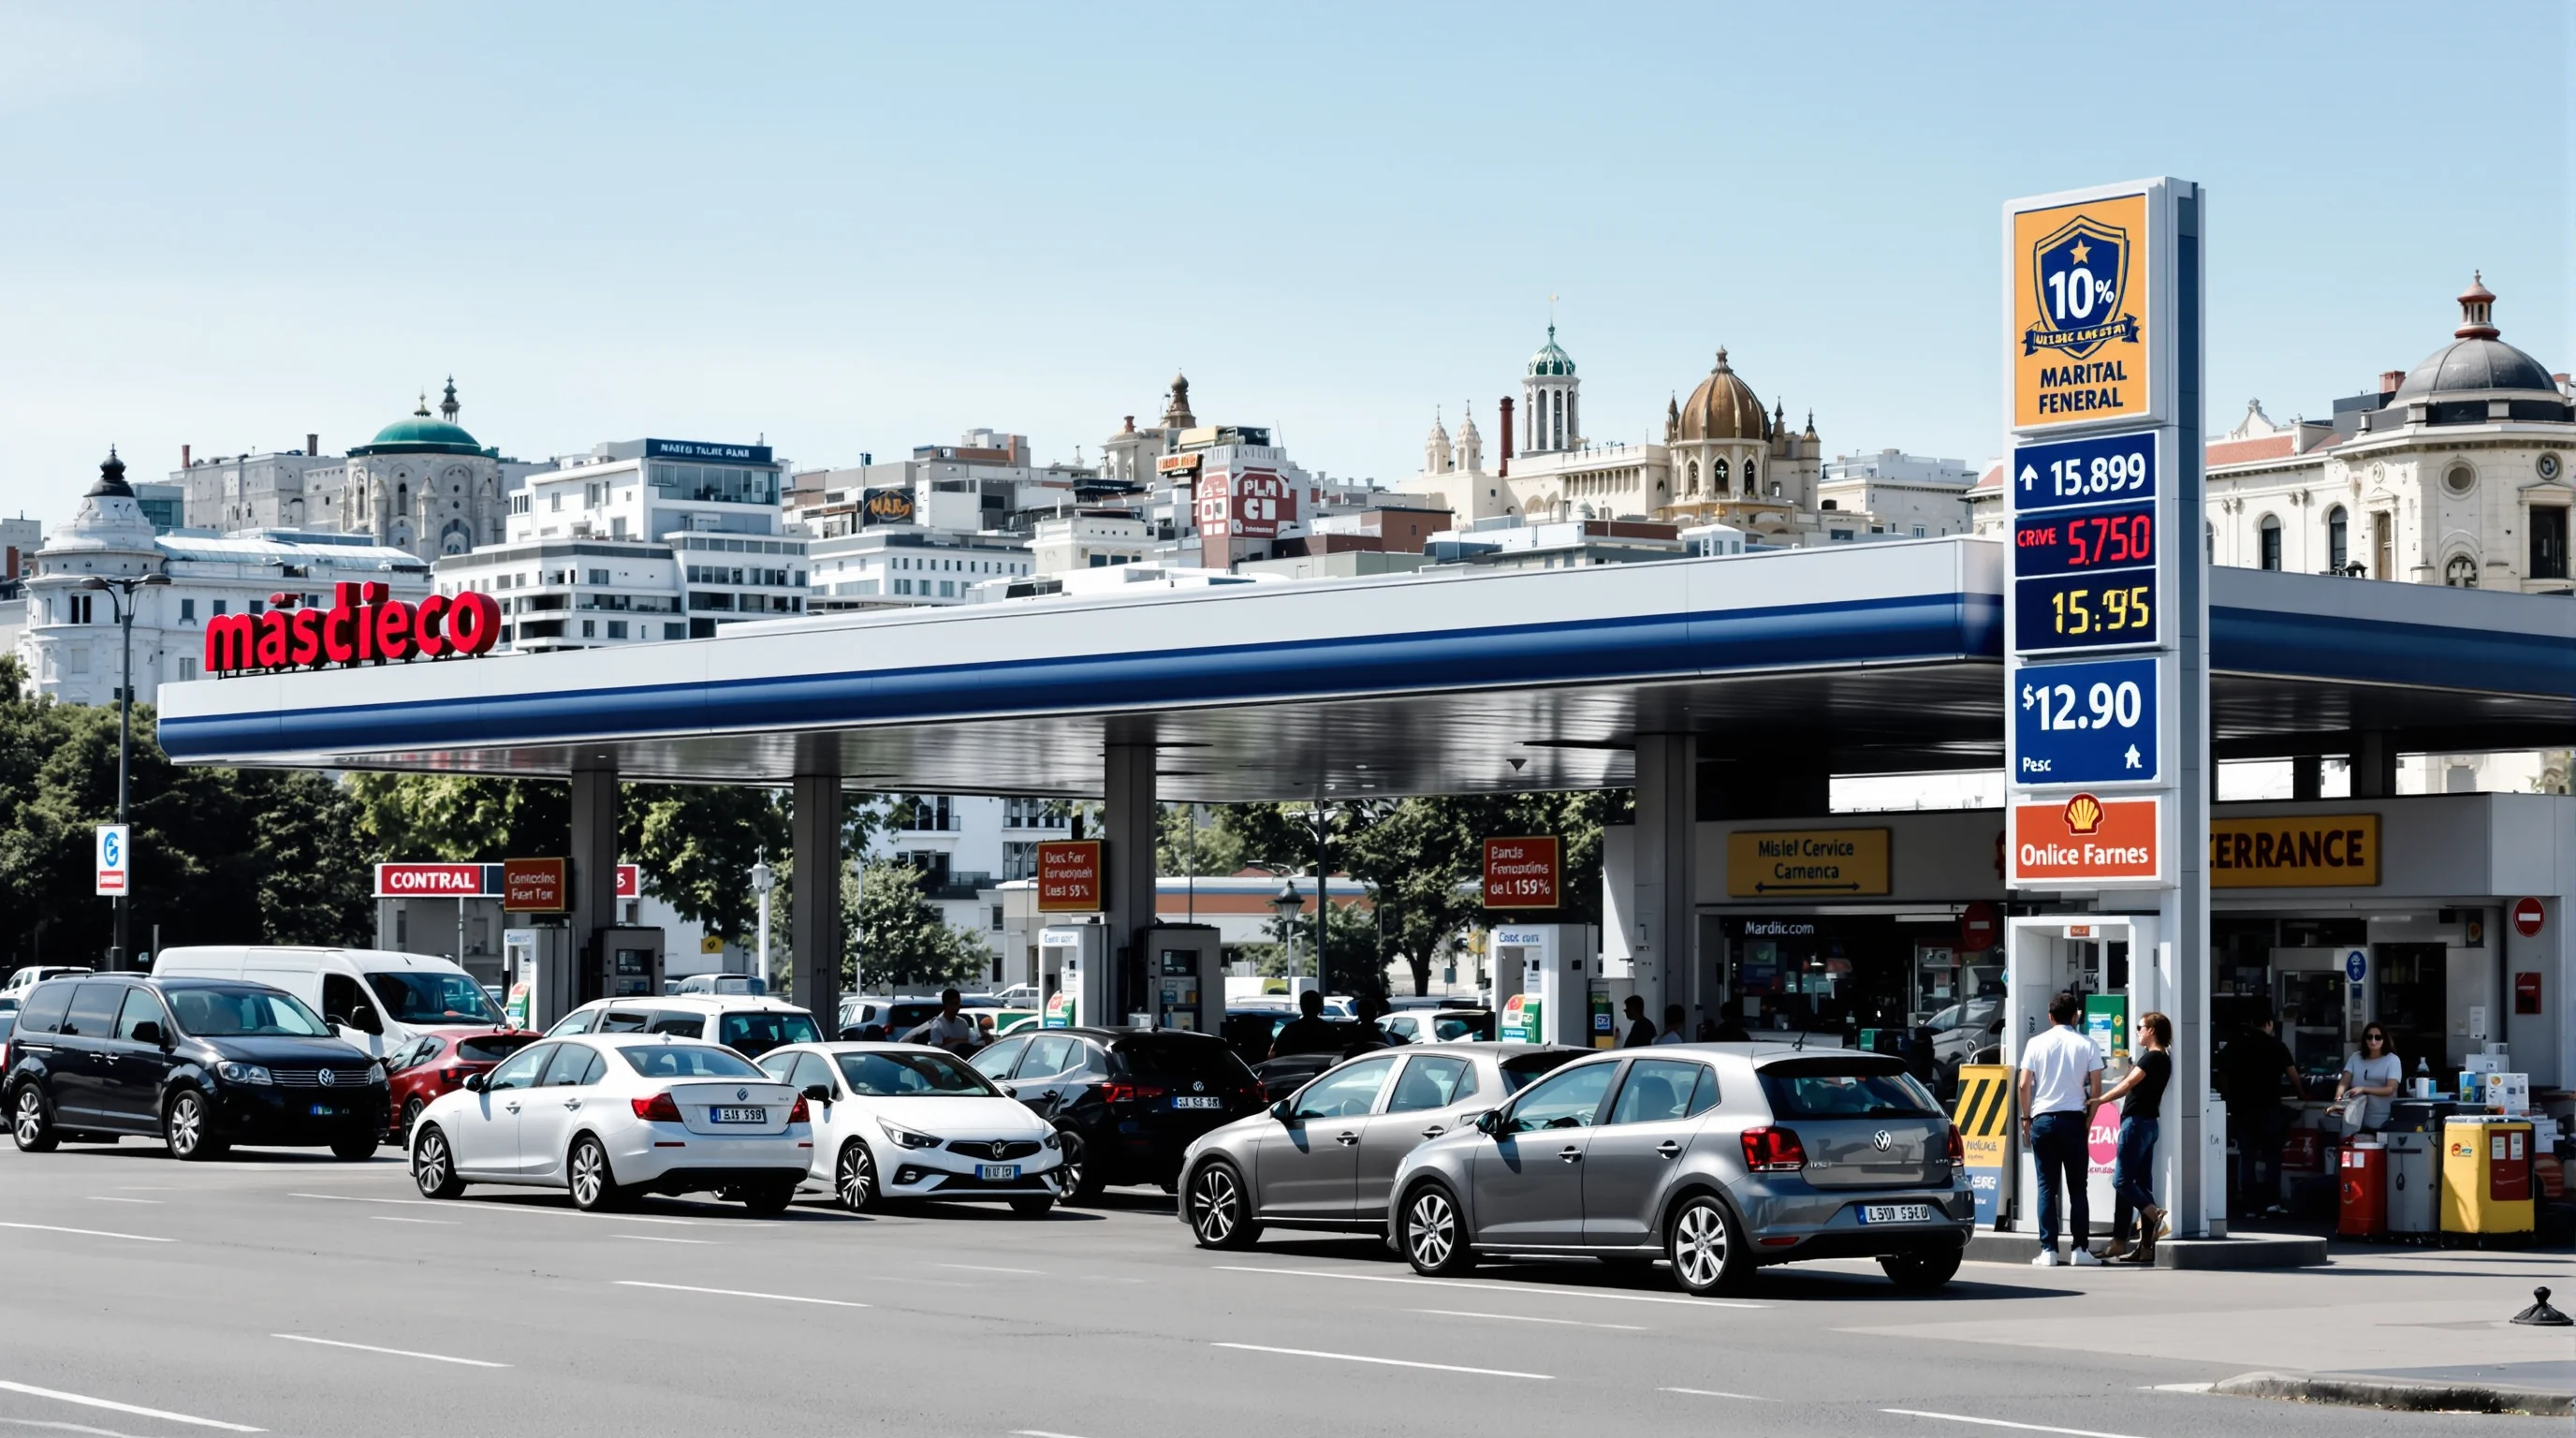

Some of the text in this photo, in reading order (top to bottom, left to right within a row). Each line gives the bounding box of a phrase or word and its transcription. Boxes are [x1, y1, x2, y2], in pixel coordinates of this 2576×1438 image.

[2048, 267, 2115, 320] 10%
[2040, 360, 2128, 389] MARITAL
[2039, 387, 2124, 415] FENERAL
[2050, 452, 2146, 497] 15.899
[2017, 528, 2057, 547] CRIVE
[2022, 681, 2142, 731] $12.90
[2022, 756, 2052, 772] Pesc
[2021, 844, 2149, 866] Onlice Farnes
[389, 871, 476, 889] CONTRAL
